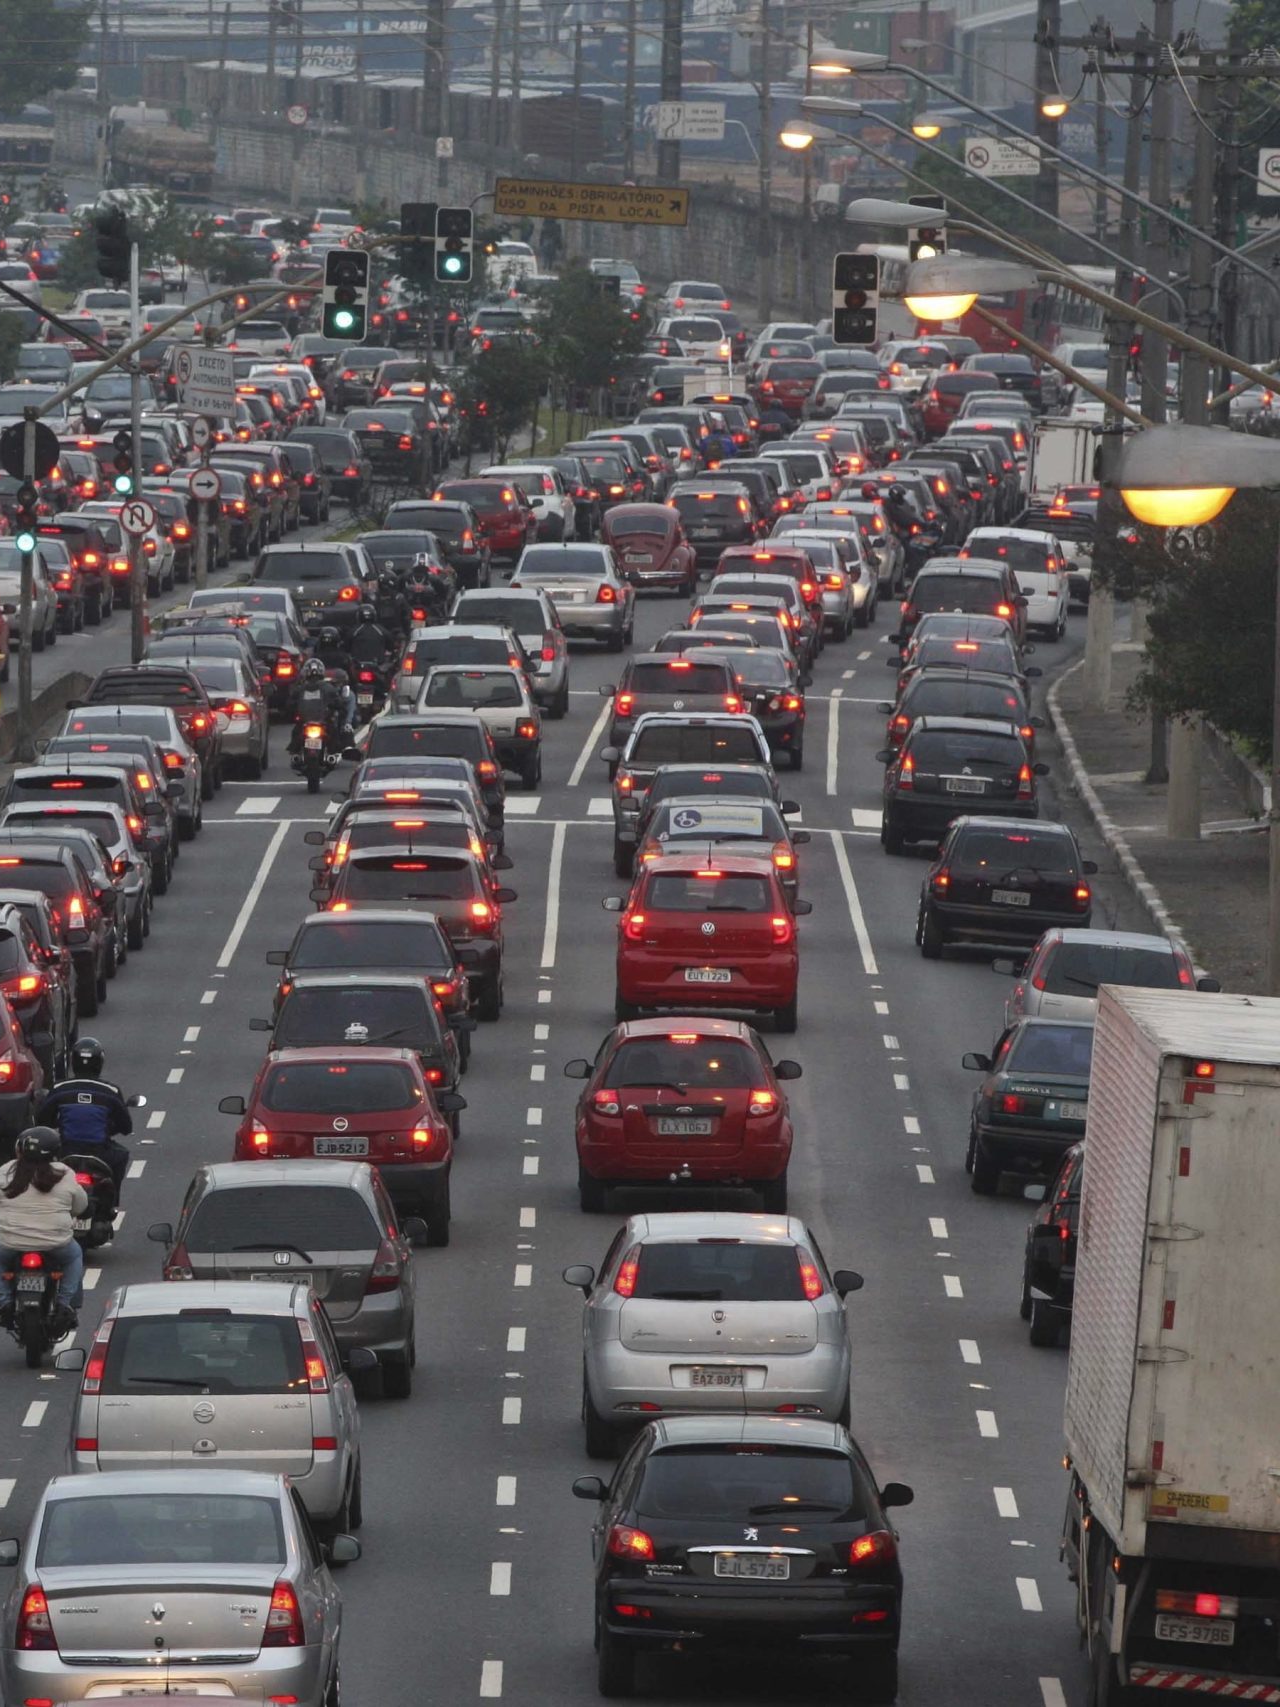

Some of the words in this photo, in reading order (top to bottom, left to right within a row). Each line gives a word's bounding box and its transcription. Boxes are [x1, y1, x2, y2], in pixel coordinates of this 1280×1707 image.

[498, 198, 526, 209] USO
[539, 201, 557, 212] DA
[569, 203, 605, 215] PISTA
[619, 206, 662, 219] LOCAL
[198, 356, 226, 370] EXCETO
